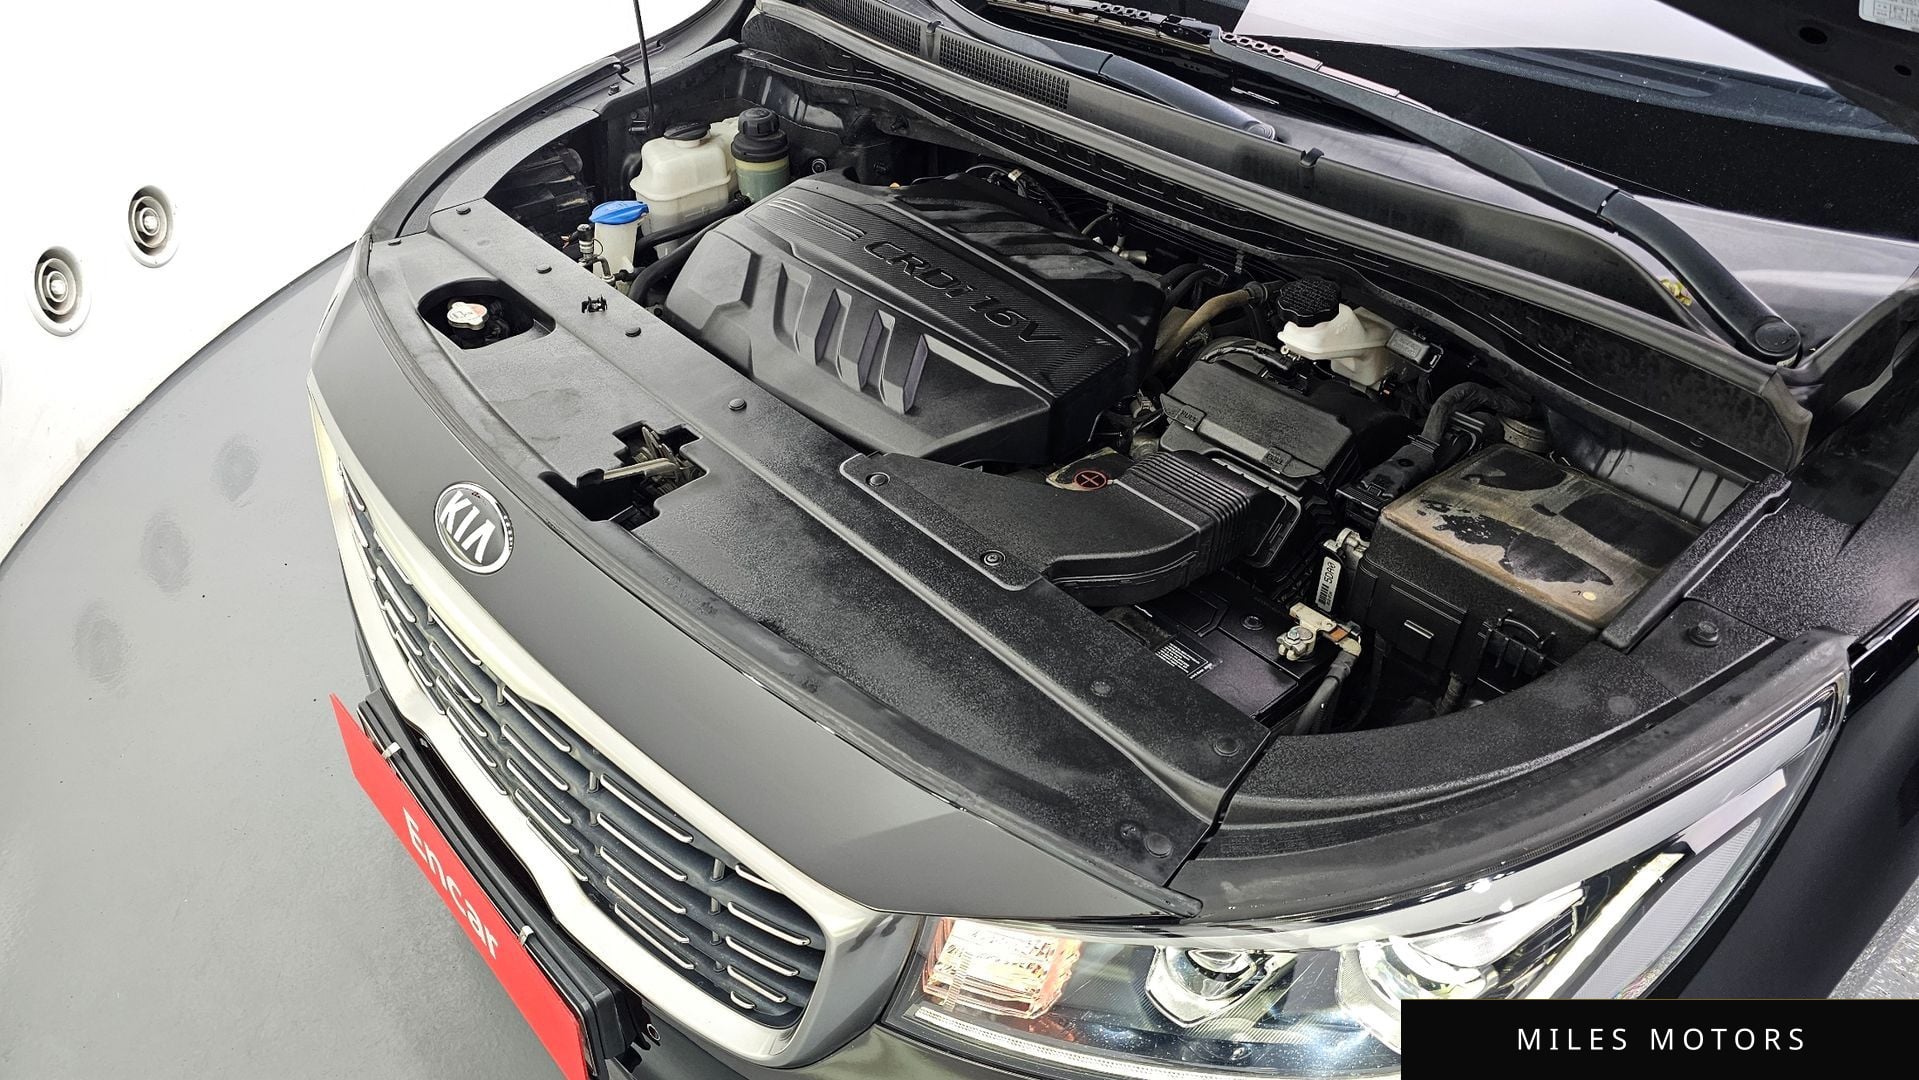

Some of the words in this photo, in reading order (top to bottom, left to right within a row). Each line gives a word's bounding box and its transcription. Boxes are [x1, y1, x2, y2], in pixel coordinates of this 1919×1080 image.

[969, 295, 1064, 343] 16V
[1180, 409, 1198, 423] PULL
[439, 490, 496, 563] KIA
[403, 806, 498, 960] Encar
